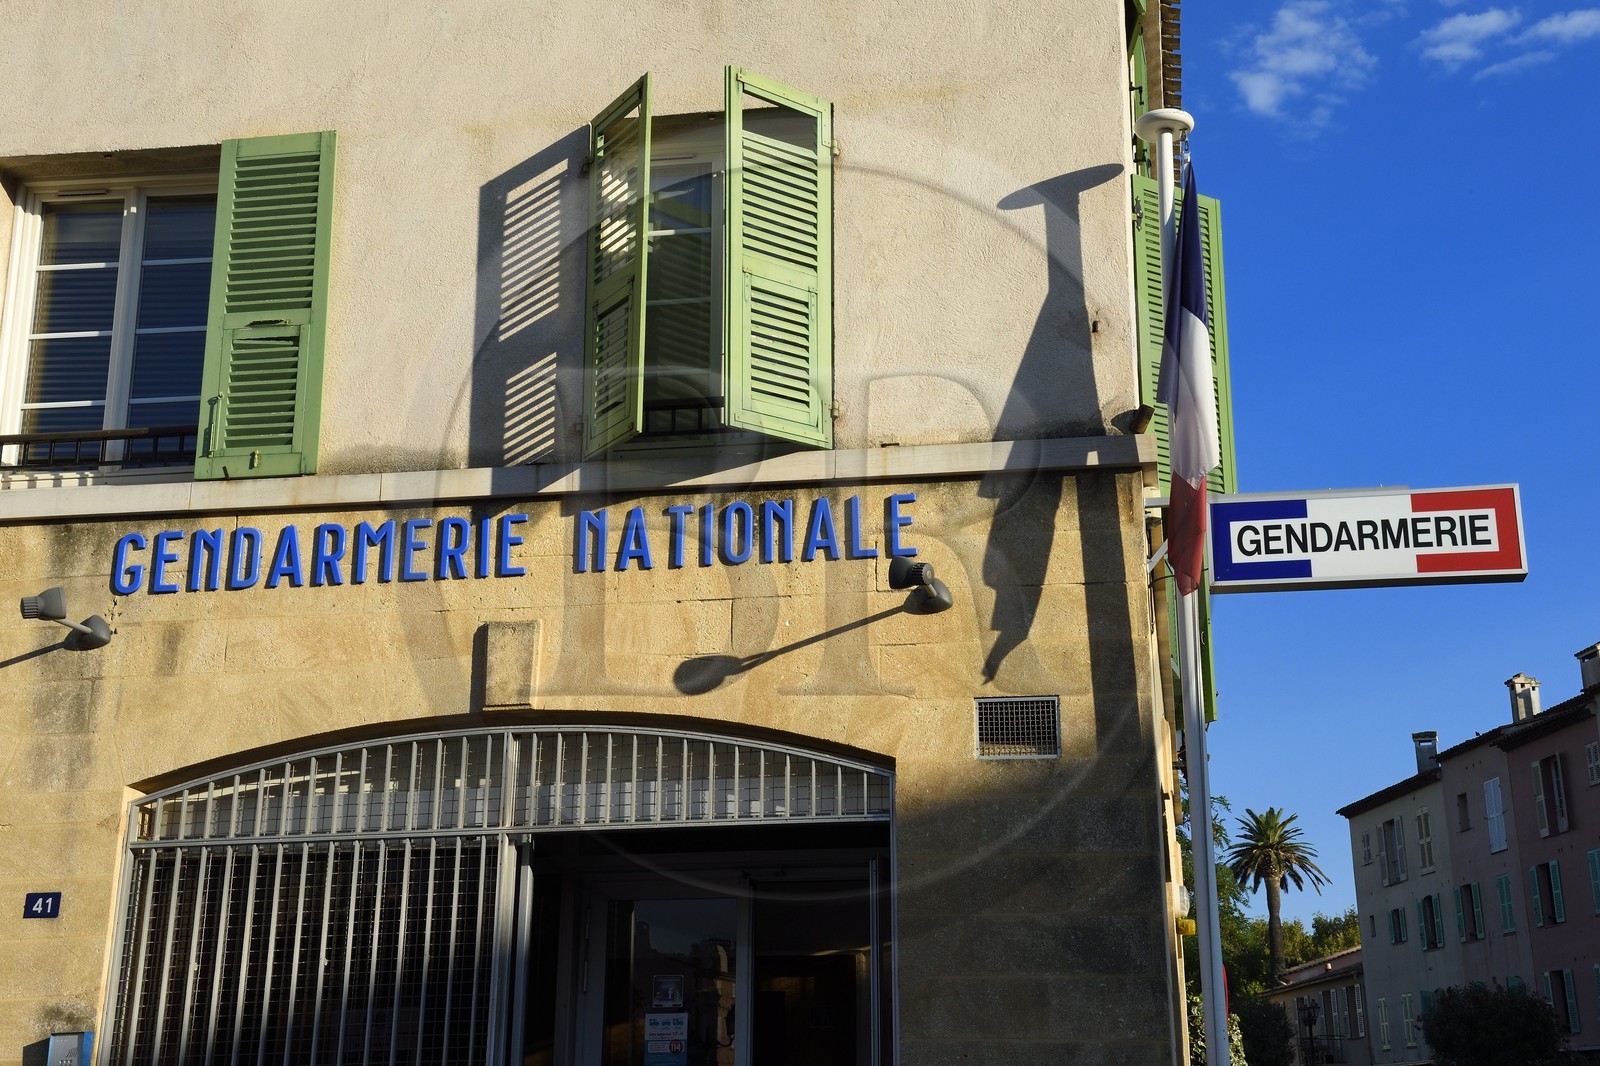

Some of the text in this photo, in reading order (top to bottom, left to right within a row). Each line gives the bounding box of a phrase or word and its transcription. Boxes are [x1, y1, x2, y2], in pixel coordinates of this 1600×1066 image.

[114, 493, 919, 594] GENDARMERIE NATIONALE
[1236, 514, 1492, 557] GENDARMERIE
[32, 897, 53, 913] 41
[670, 1043, 681, 1052] 114
